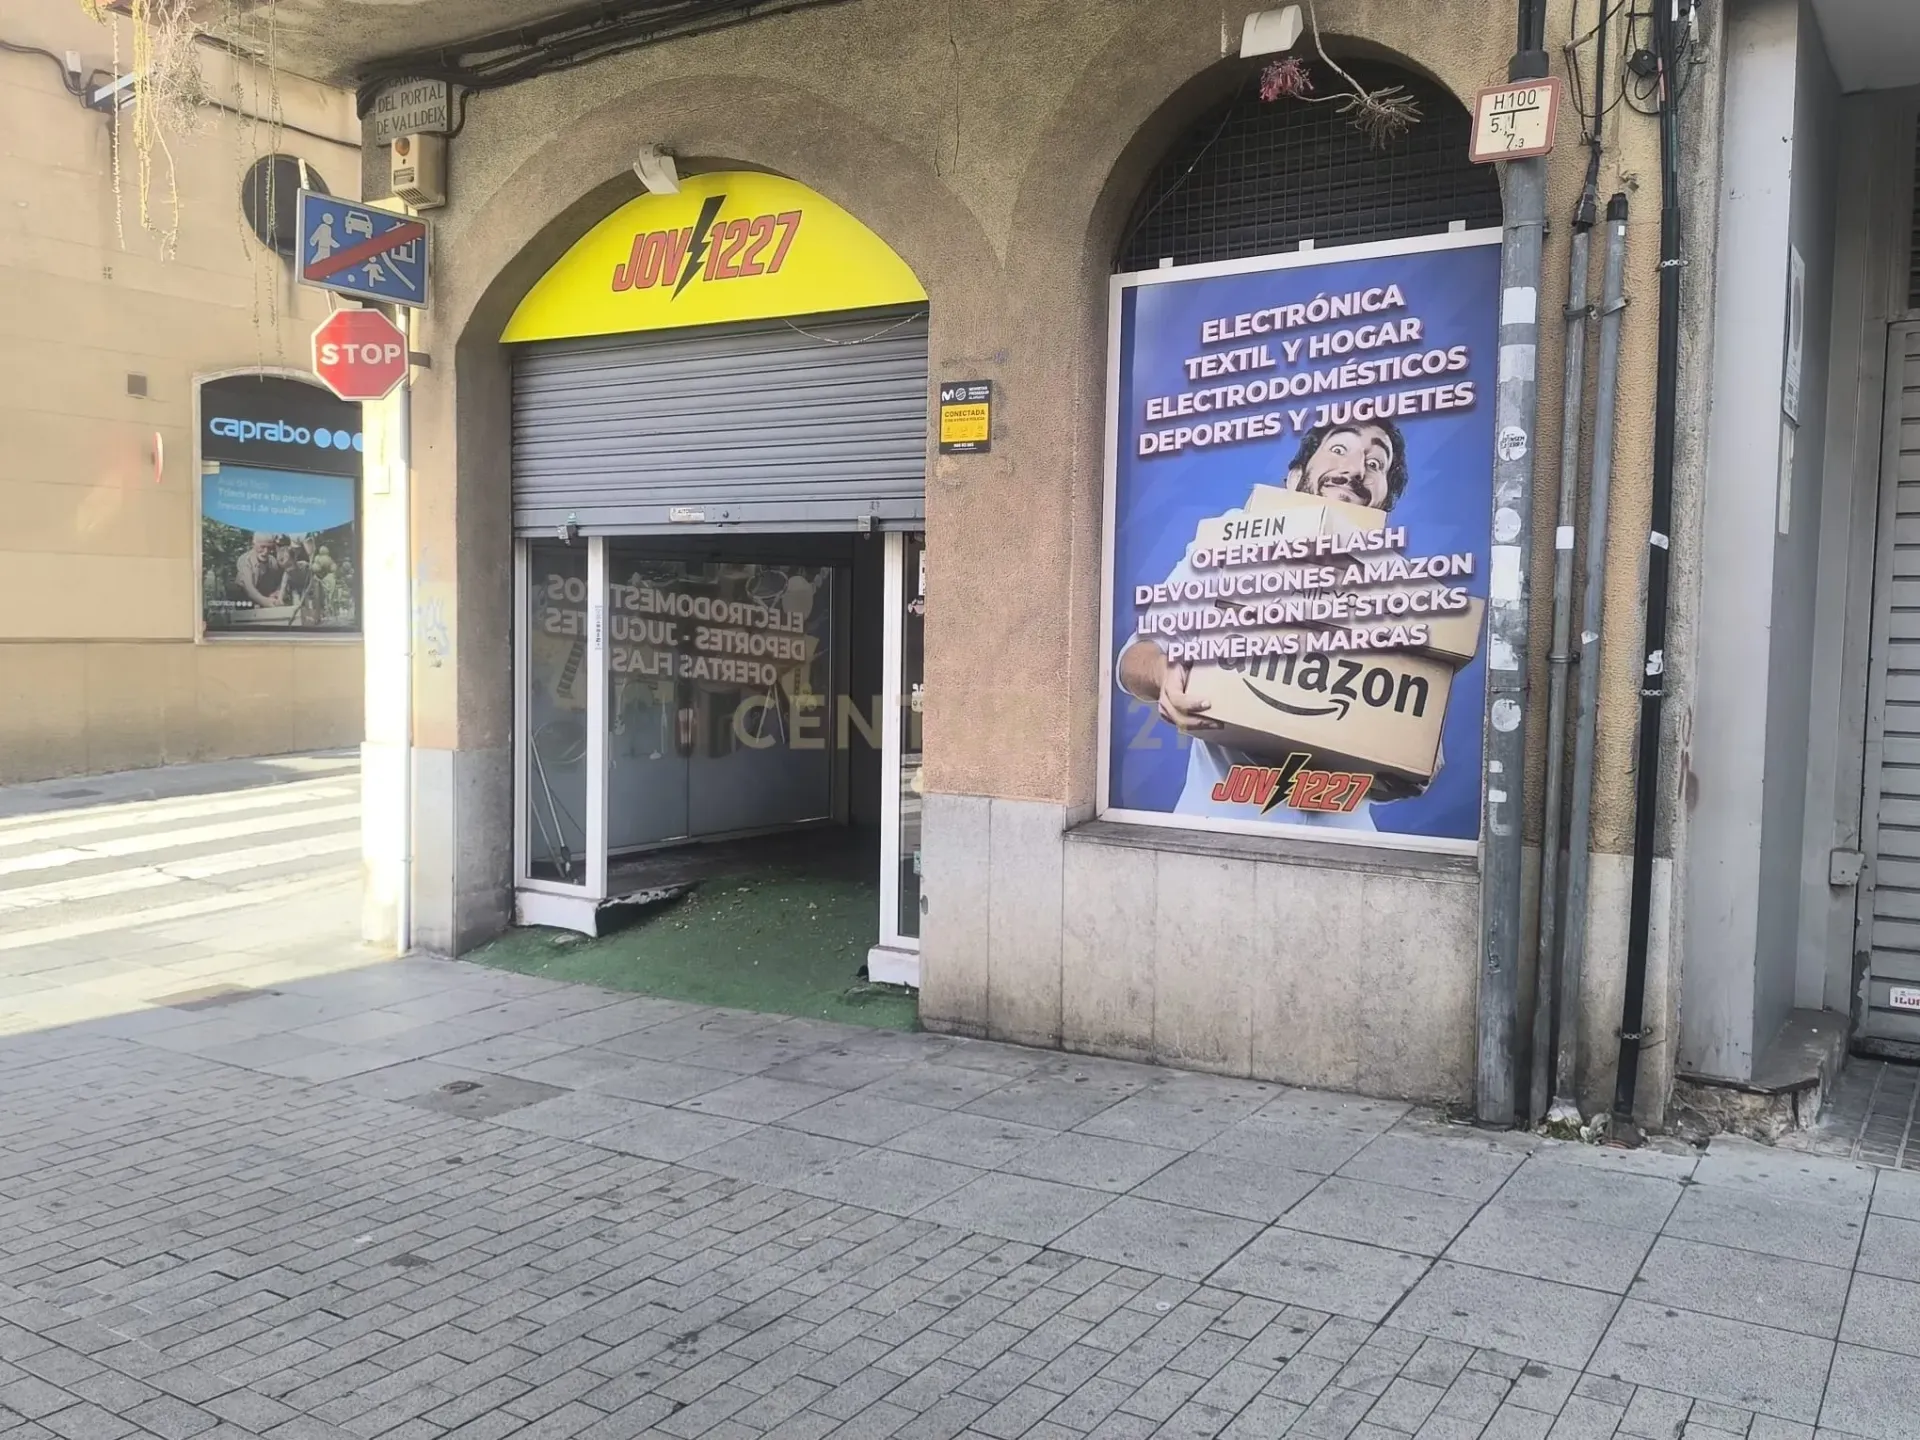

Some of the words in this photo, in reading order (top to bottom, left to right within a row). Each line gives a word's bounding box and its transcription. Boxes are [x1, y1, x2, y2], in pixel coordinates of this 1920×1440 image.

[377, 92, 398, 113] DEL
[401, 83, 445, 109] PORTAL
[376, 118, 390, 136] DE
[392, 105, 446, 132] VALLDEIX
[1202, 284, 1406, 344] ELECTRÓNICA
[320, 343, 402, 367] STOP
[1185, 345, 1275, 381] TEXTIL
[1282, 339, 1302, 363] Y
[1309, 318, 1423, 359] HOGAR
[1145, 346, 1468, 421] ELECTRODOMÉSTICOS
[210, 417, 311, 443] caprabo
[1138, 413, 1281, 456] DEPORTES
[1289, 407, 1311, 432] Y
[1314, 382, 1475, 429] JUGUETES
[1192, 537, 1309, 568] OFERTAS
[1315, 527, 1406, 556] FLASH
[1222, 516, 1286, 541] SHEIN
[1135, 567, 1336, 605] DEVOLUCIONES
[1342, 553, 1473, 586] AMAZON
[1138, 598, 1304, 635] LIQUIDACIÓN
[1311, 598, 1349, 620] DE
[1355, 587, 1468, 617] STOCKS
[1168, 632, 1299, 663] PRIMERAS
[1306, 624, 1428, 655] MARCAS
